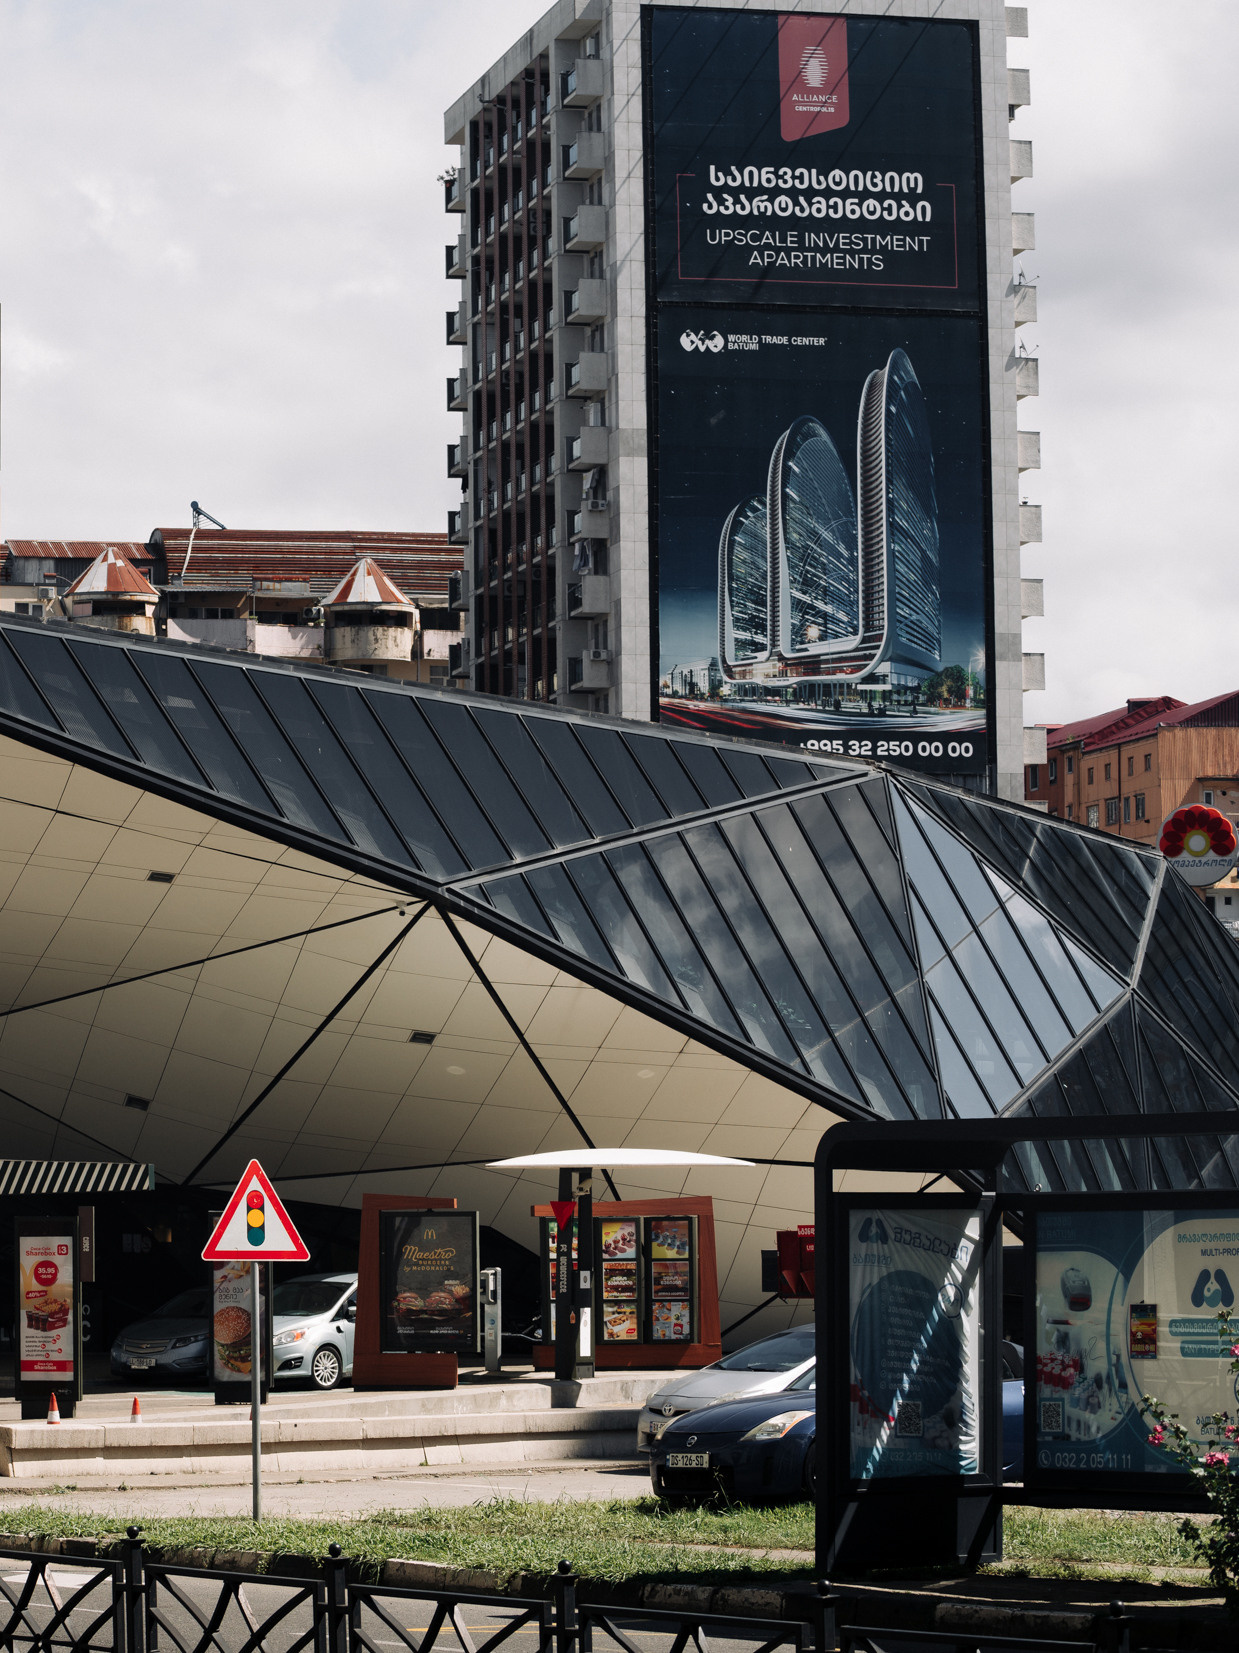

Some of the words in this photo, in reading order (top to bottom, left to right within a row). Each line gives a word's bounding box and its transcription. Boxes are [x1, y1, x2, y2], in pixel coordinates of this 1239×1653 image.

[792, 94, 838, 103] ALLIANCE
[795, 105, 835, 113] CENTROPOLIS
[710, 165, 923, 193] საინვესტიციო
[702, 193, 932, 222] აპარტამენტები
[706, 229, 799, 247] UPSCALE
[805, 232, 931, 252] INVESTMENT
[749, 251, 884, 271] APARTMENTS
[728, 334, 758, 343] WORLD
[761, 336, 789, 344] TRADE
[791, 337, 826, 346] CENTER
[847, 740, 872, 757] 32
[876, 741, 911, 757] 250
[917, 742, 944, 757] 00
[947, 742, 974, 757] 00
[402, 1245, 456, 1261] Maestro
[671, 1455, 704, 1466] DS-126-SD
[1055, 1453, 1076, 1467] 032
[1079, 1453, 1087, 1467] 2
[1090, 1453, 1104, 1467] 05
[1108, 1454, 1118, 1467] 11
[1121, 1454, 1131, 1467] 11
